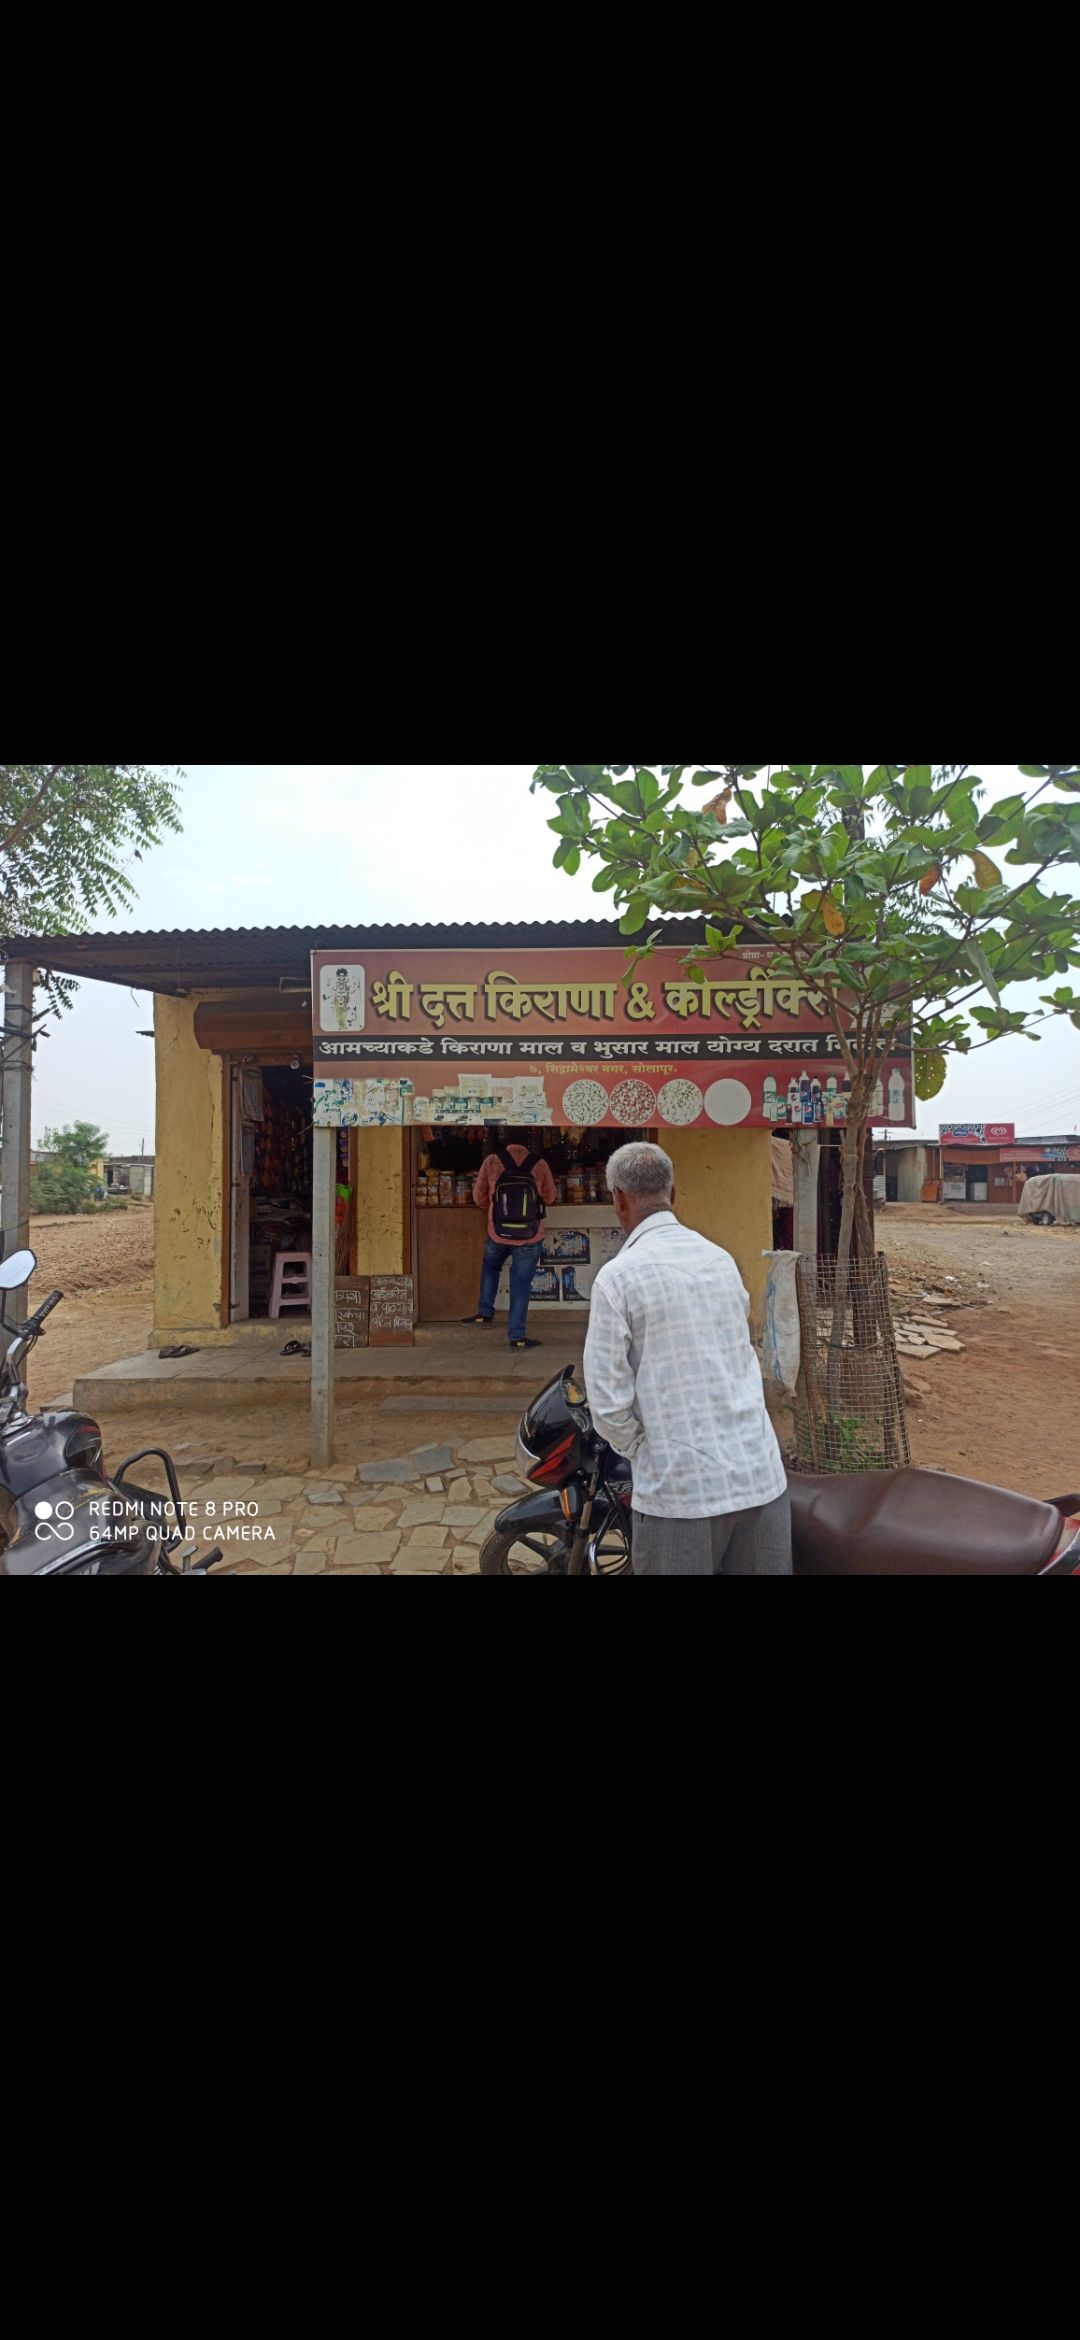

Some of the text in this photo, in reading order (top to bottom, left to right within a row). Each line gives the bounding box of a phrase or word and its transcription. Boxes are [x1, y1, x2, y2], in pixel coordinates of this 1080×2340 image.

[371, 970, 414, 1020] श्री
[420, 983, 478, 1027] दत्त
[485, 971, 617, 1020] किराणा
[627, 982, 655, 1019] &
[319, 1037, 434, 1055] आमच्याकडे
[441, 1038, 511, 1055] किराणा
[520, 1041, 563, 1055] माल
[571, 1041, 588, 1055] व
[594, 1041, 648, 1058] भुसार
[655, 1040, 700, 1055] माल
[707, 1036, 760, 1053] योग्य
[769, 1039, 820, 1053] दरात
[601, 1065, 628, 1075] नगर,
